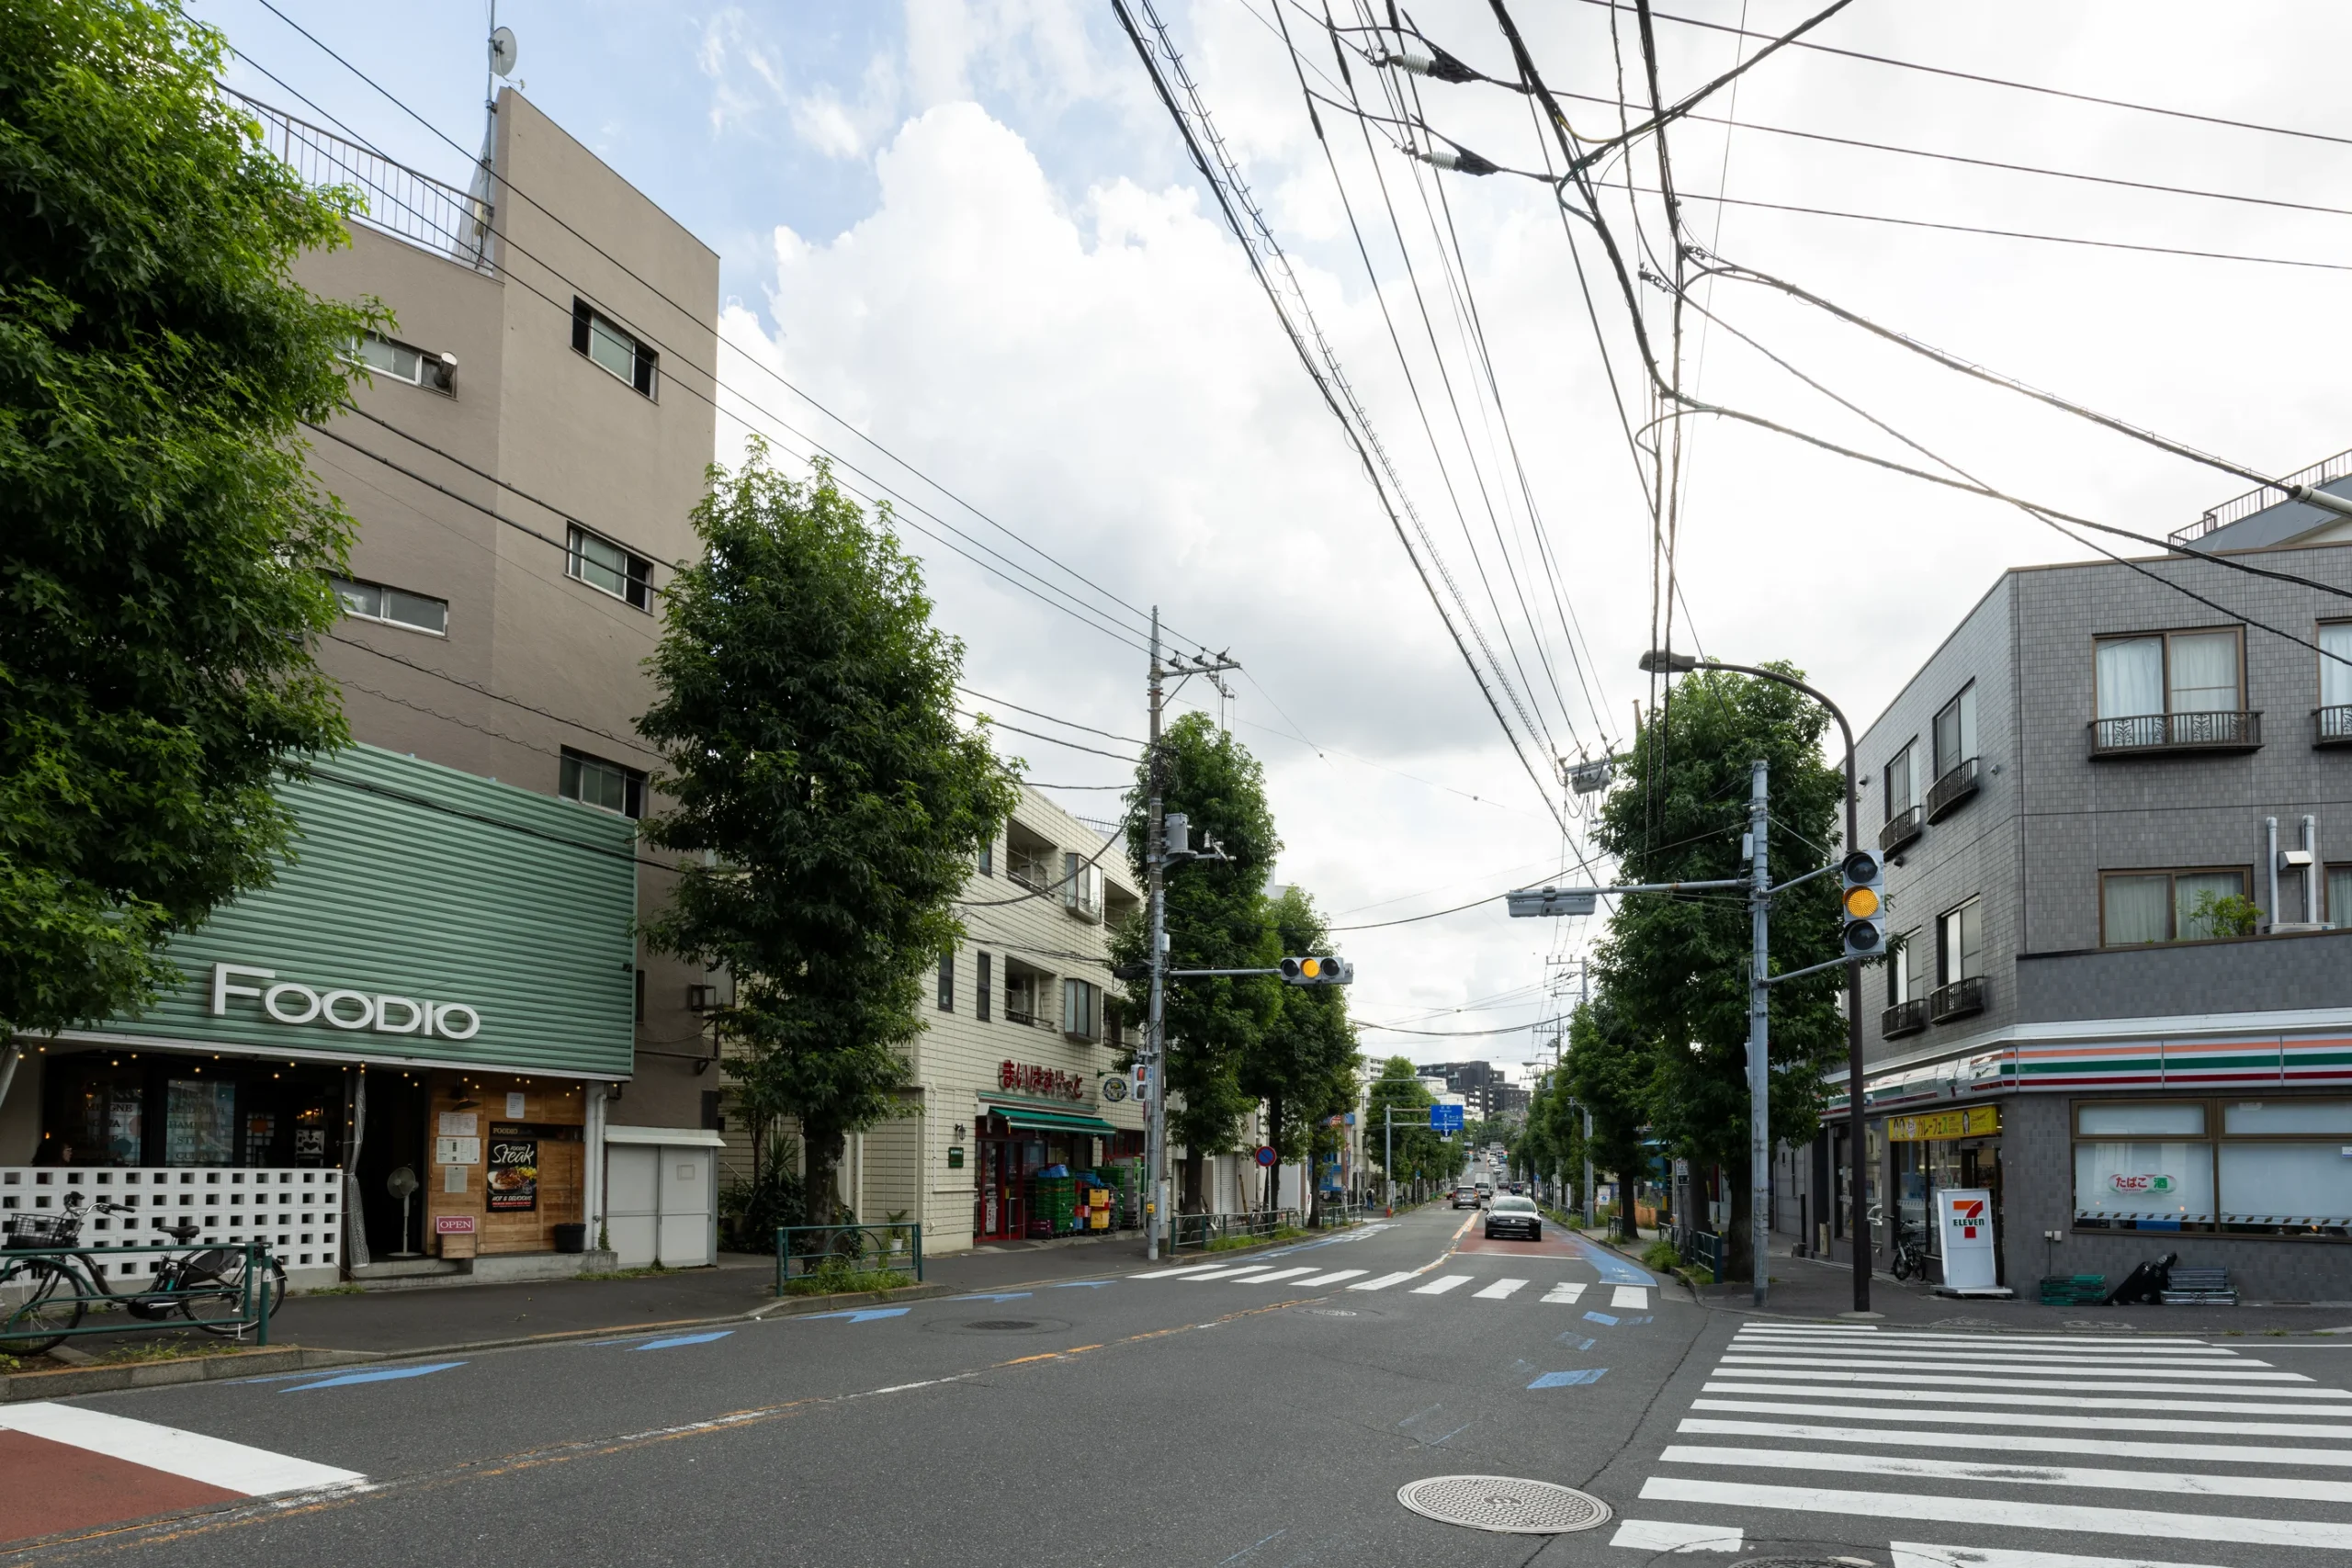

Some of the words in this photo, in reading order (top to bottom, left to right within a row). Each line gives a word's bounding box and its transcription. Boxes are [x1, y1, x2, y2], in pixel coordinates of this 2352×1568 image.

[211, 963, 481, 1040] FOODIO
[492, 1144, 534, 1165] Steak
[2116, 1177, 2148, 1189] たばこ
[2154, 1177, 2168, 1189] 酒
[439, 1221, 472, 1229] OPEN
